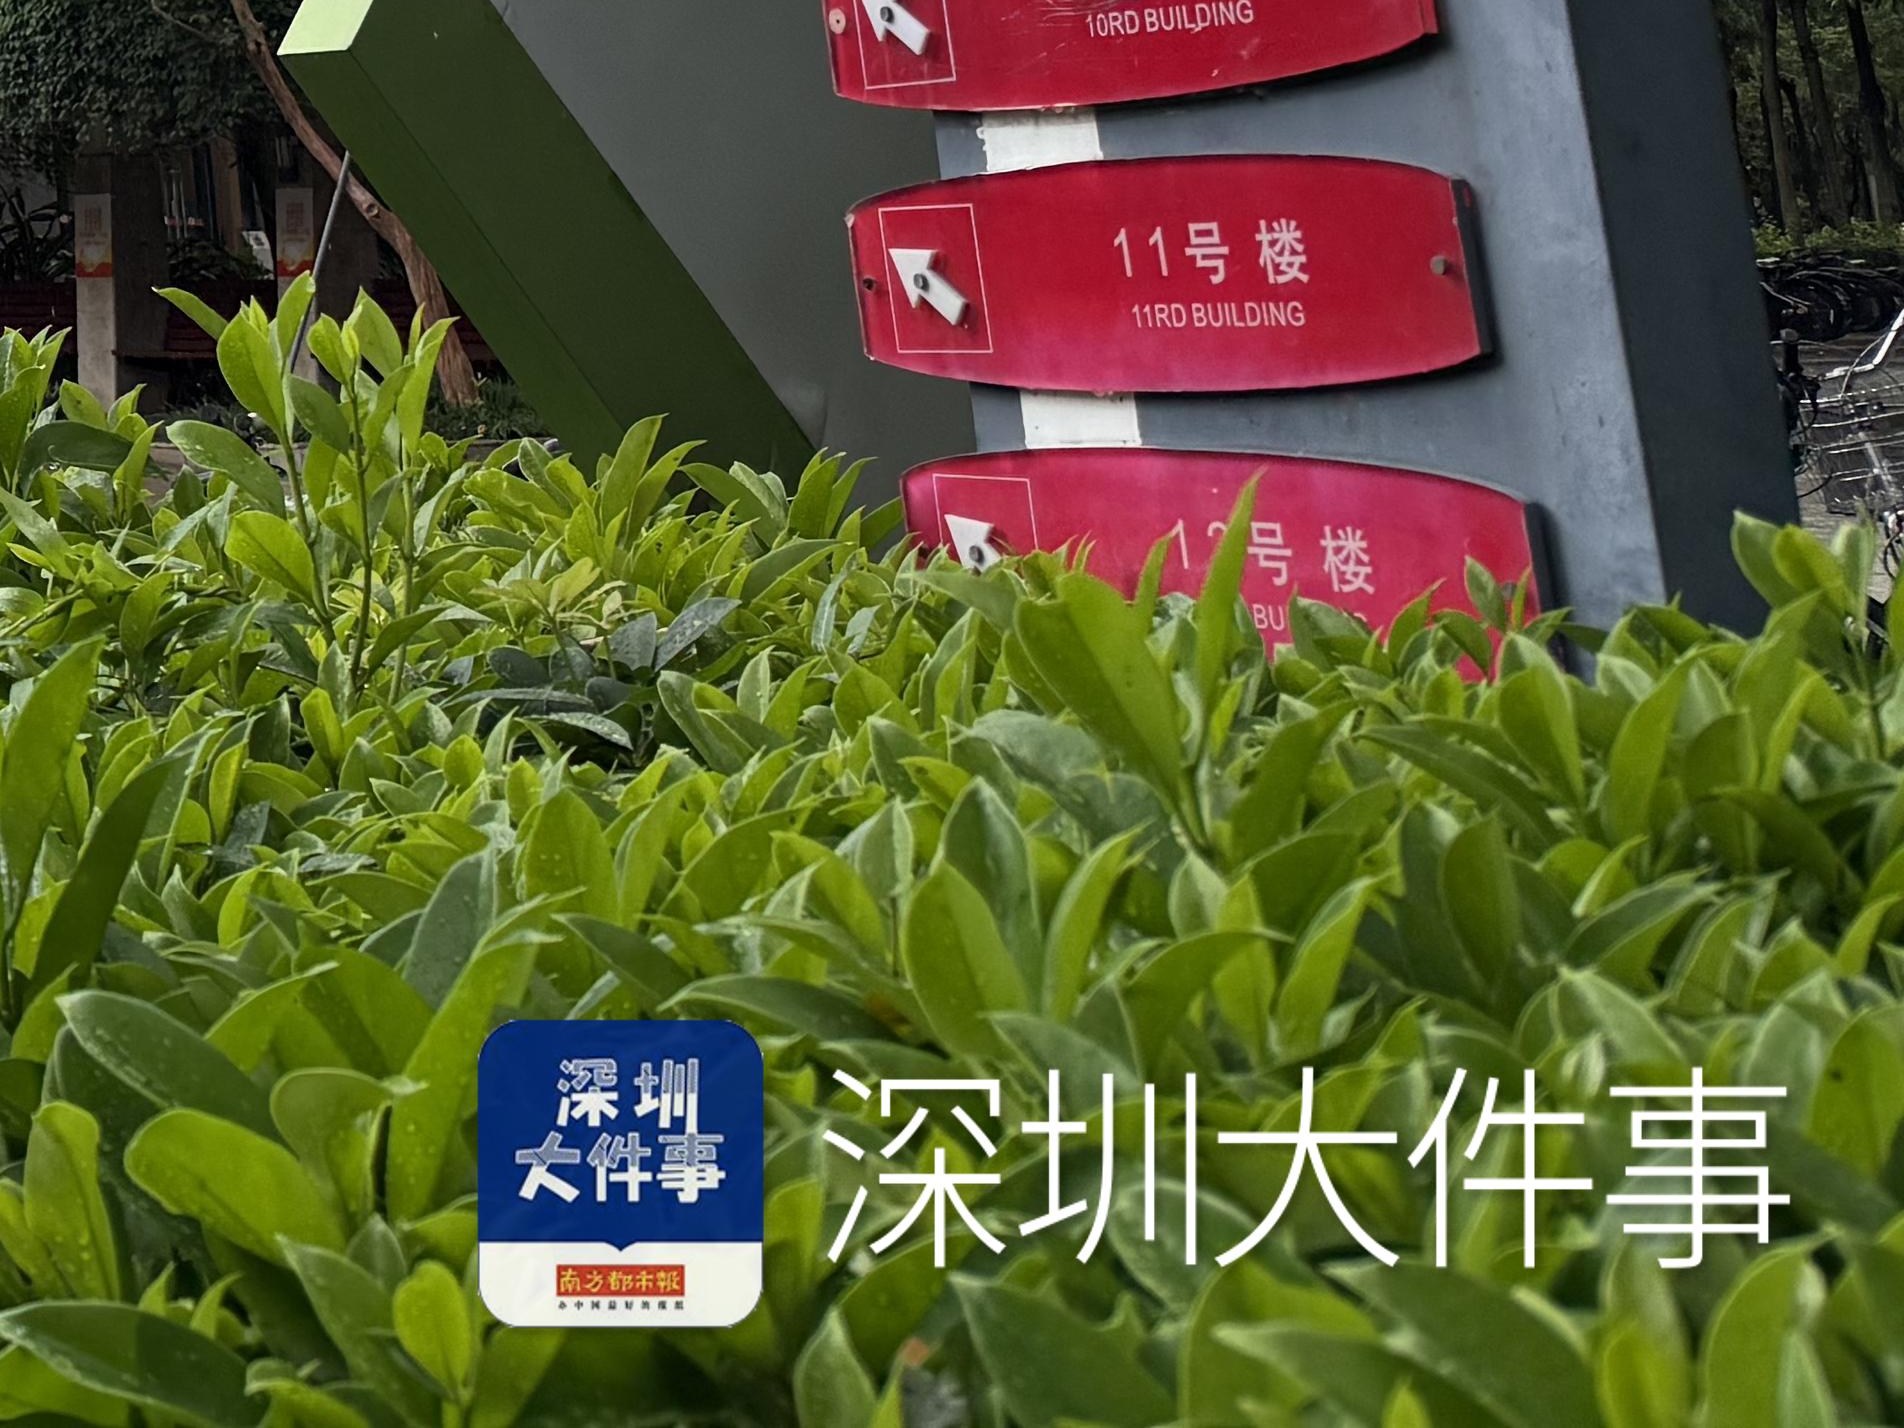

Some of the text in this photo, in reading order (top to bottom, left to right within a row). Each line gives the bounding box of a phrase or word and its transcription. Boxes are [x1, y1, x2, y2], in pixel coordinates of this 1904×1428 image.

[1085, 0, 1255, 38] 10RD BUILDING
[1132, 301, 1306, 328] 11RD BUILDING
